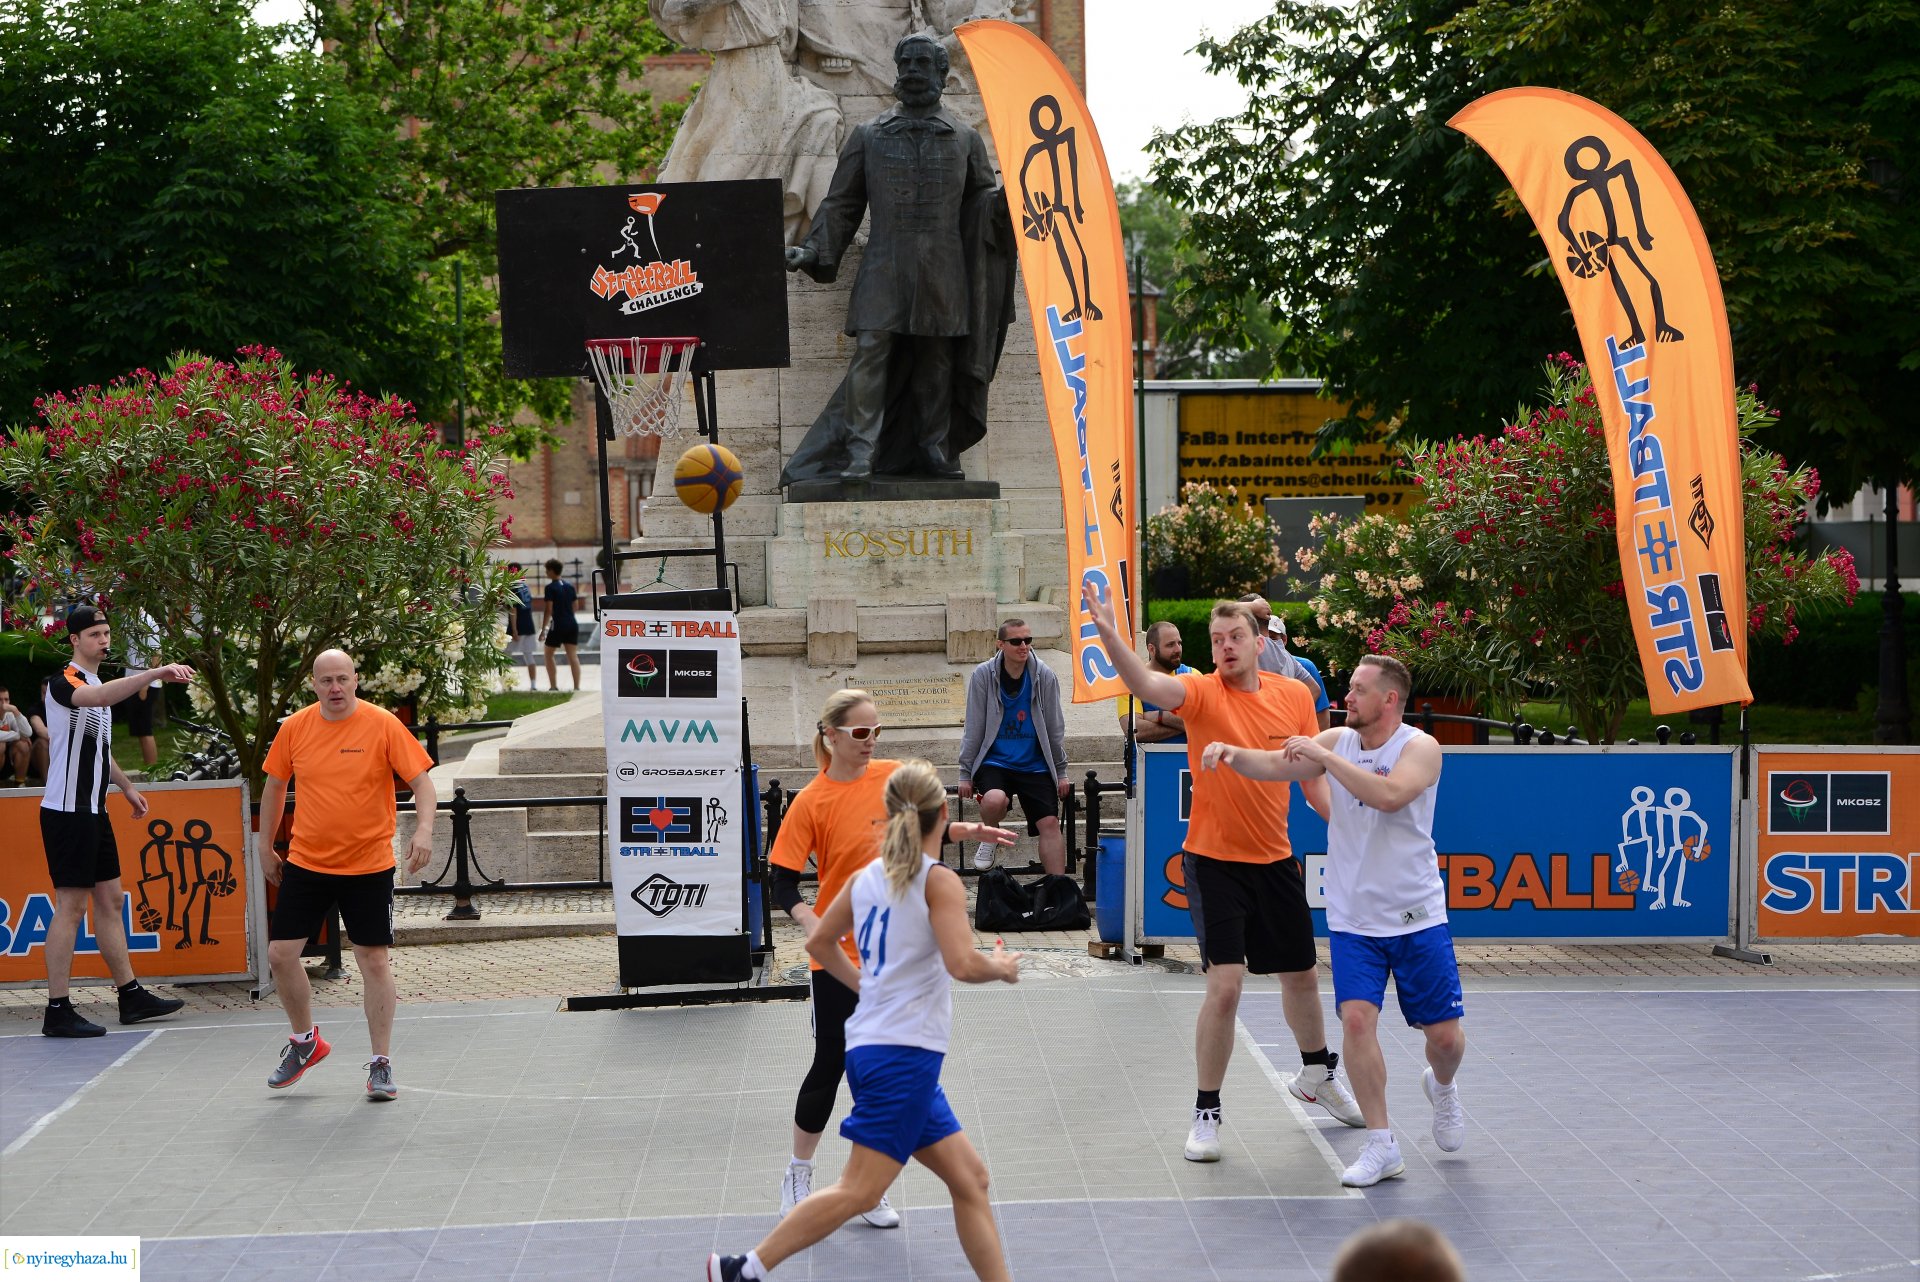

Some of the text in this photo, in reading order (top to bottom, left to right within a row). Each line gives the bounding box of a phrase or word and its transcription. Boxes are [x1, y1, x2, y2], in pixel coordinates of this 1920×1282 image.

[629, 284, 698, 312] CHALLENGE
[1179, 431, 1229, 445] FaBa
[824, 528, 973, 558] KOSSUTH
[605, 619, 737, 638] STREETBALL
[872, 688, 909, 697] KOSSUTH
[917, 687, 949, 695] SZOBOR
[620, 719, 719, 744] MVM
[620, 767, 635, 776] GB
[1836, 798, 1882, 806] MKOSZ
[648, 883, 709, 908] TOTI
[1761, 852, 1920, 914] STR
[857, 905, 891, 977] 41
